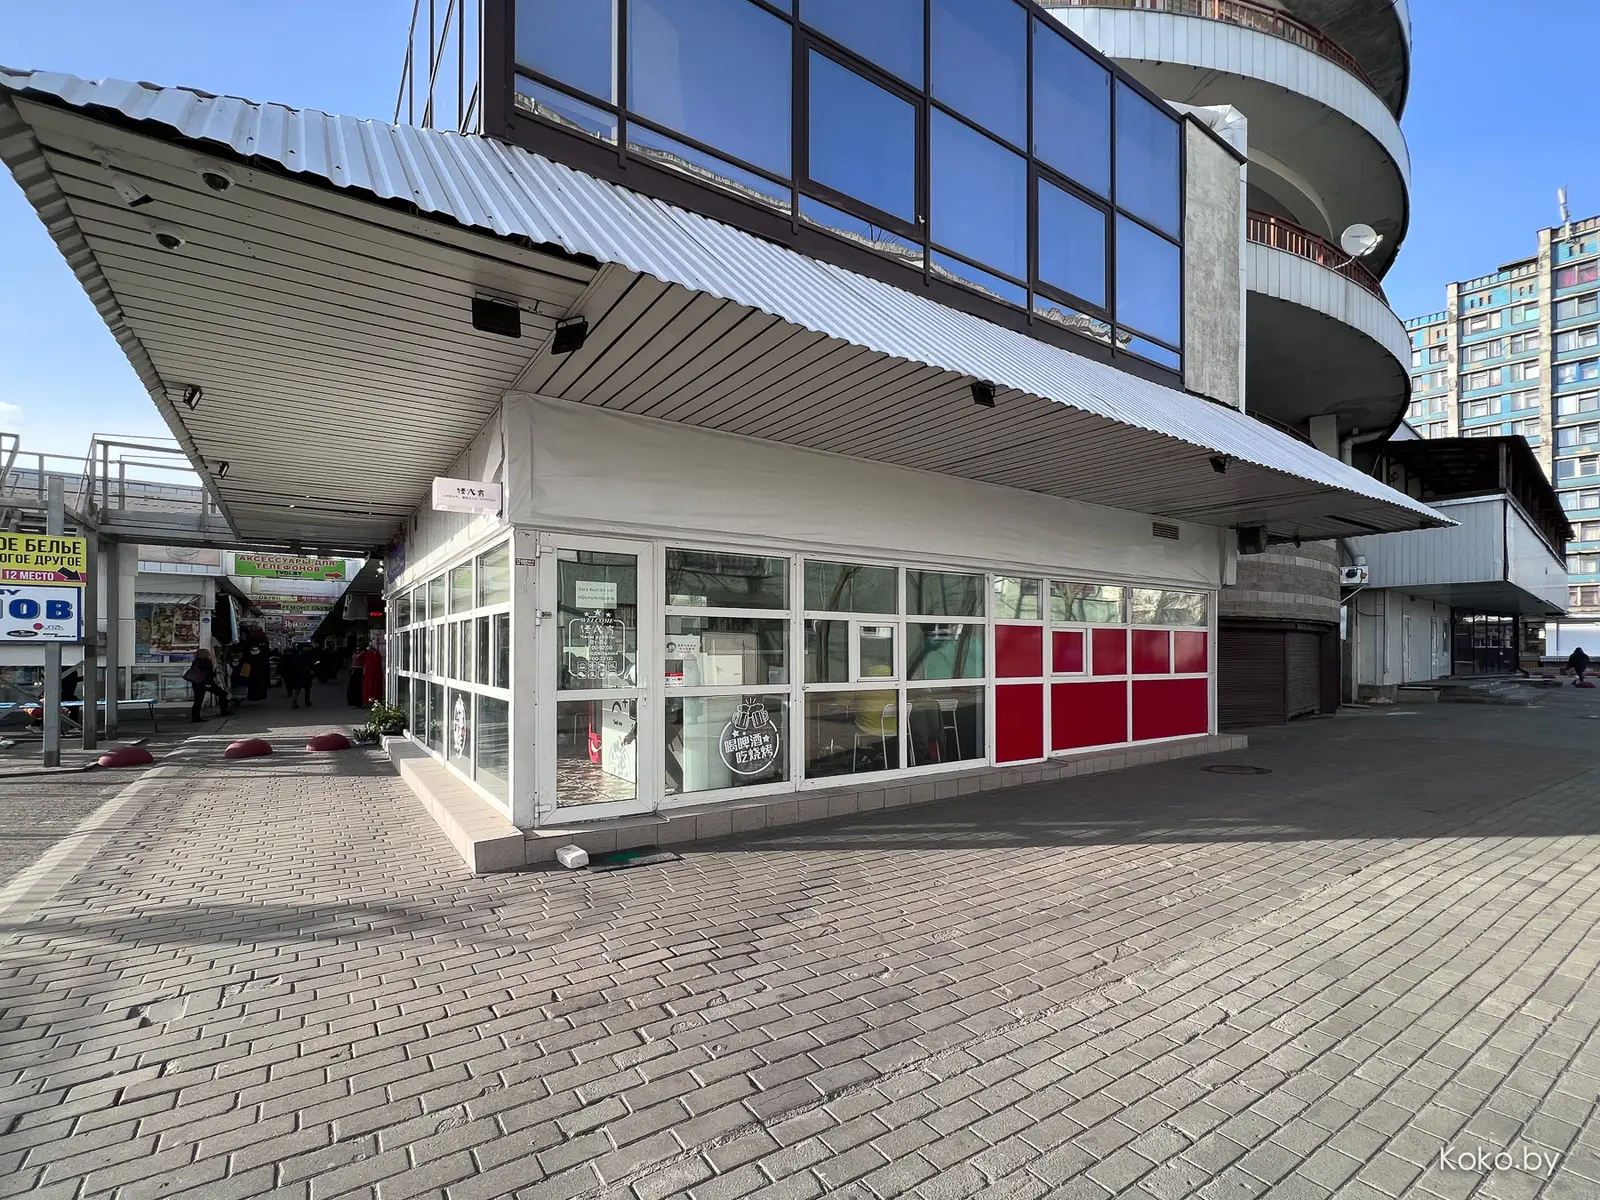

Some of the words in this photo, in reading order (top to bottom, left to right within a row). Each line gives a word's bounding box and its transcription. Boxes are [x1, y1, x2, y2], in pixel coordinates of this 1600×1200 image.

[25, 538, 82, 555] БЕЛЬЕ
[34, 555, 82, 567] ДРУГОЕ
[239, 555, 312, 566] АКСЕССУАРЫ
[314, 559, 335, 567] ДЛЯ
[255, 563, 321, 572] ТЕЛЕФОНОВ
[5, 570, 17, 580] 12
[20, 571, 54, 581] МЕСТО
[0, 598, 74, 620] ОВ
